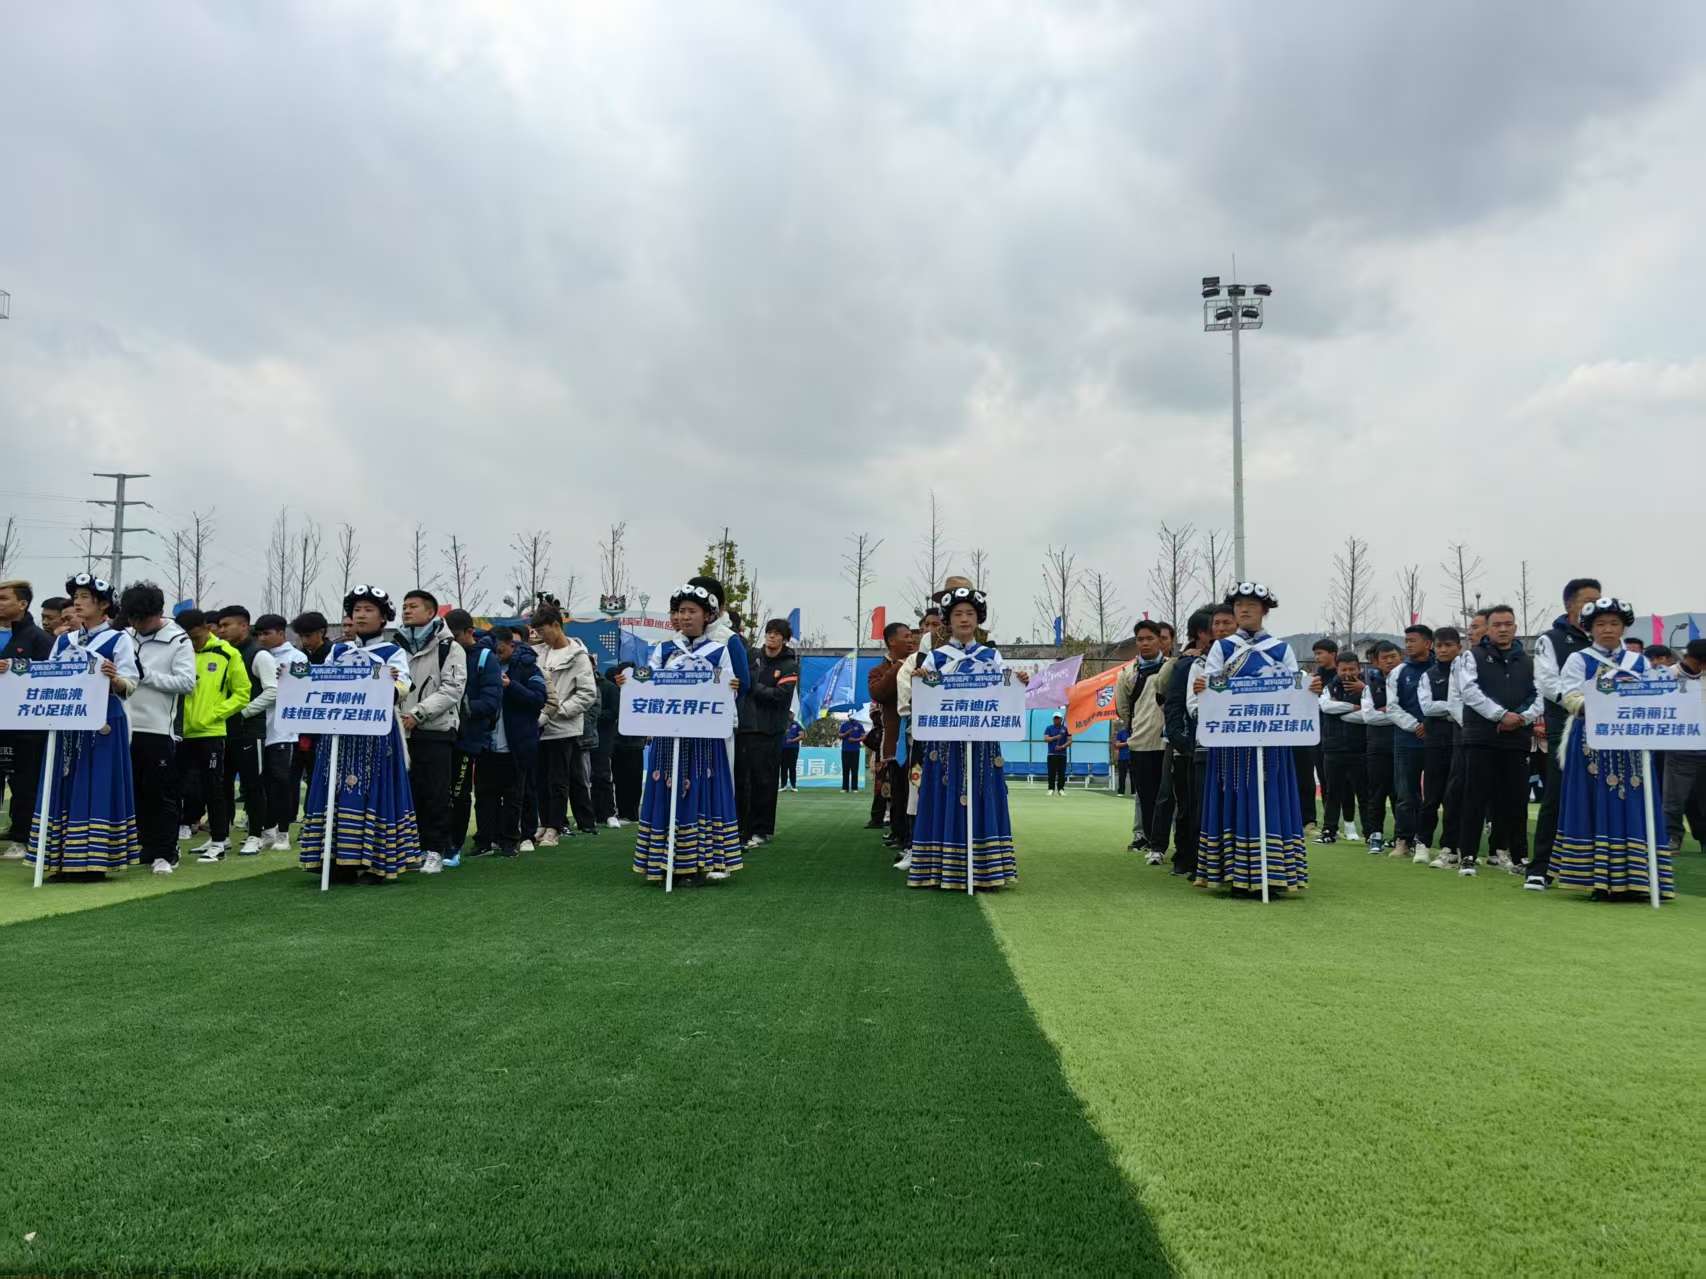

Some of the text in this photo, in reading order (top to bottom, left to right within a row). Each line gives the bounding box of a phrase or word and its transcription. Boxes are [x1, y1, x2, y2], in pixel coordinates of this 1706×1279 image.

[26, 687, 84, 701] 甘肃临洮
[305, 691, 367, 705] 广西柳州
[17, 703, 88, 717] 齐心足球队
[631, 697, 725, 715] 安徽无界FC
[940, 699, 999, 712] 云南迪庆
[1228, 703, 1291, 717] 云南丽江
[281, 706, 387, 722] 桂恒医疗足球队
[1616, 706, 1677, 720] 云南丽江
[917, 714, 1022, 728] 香格里拉同路人足球队
[1205, 719, 1315, 733] 宁蒗足协足球队
[1594, 723, 1701, 737] 嘉兴超市足球队
